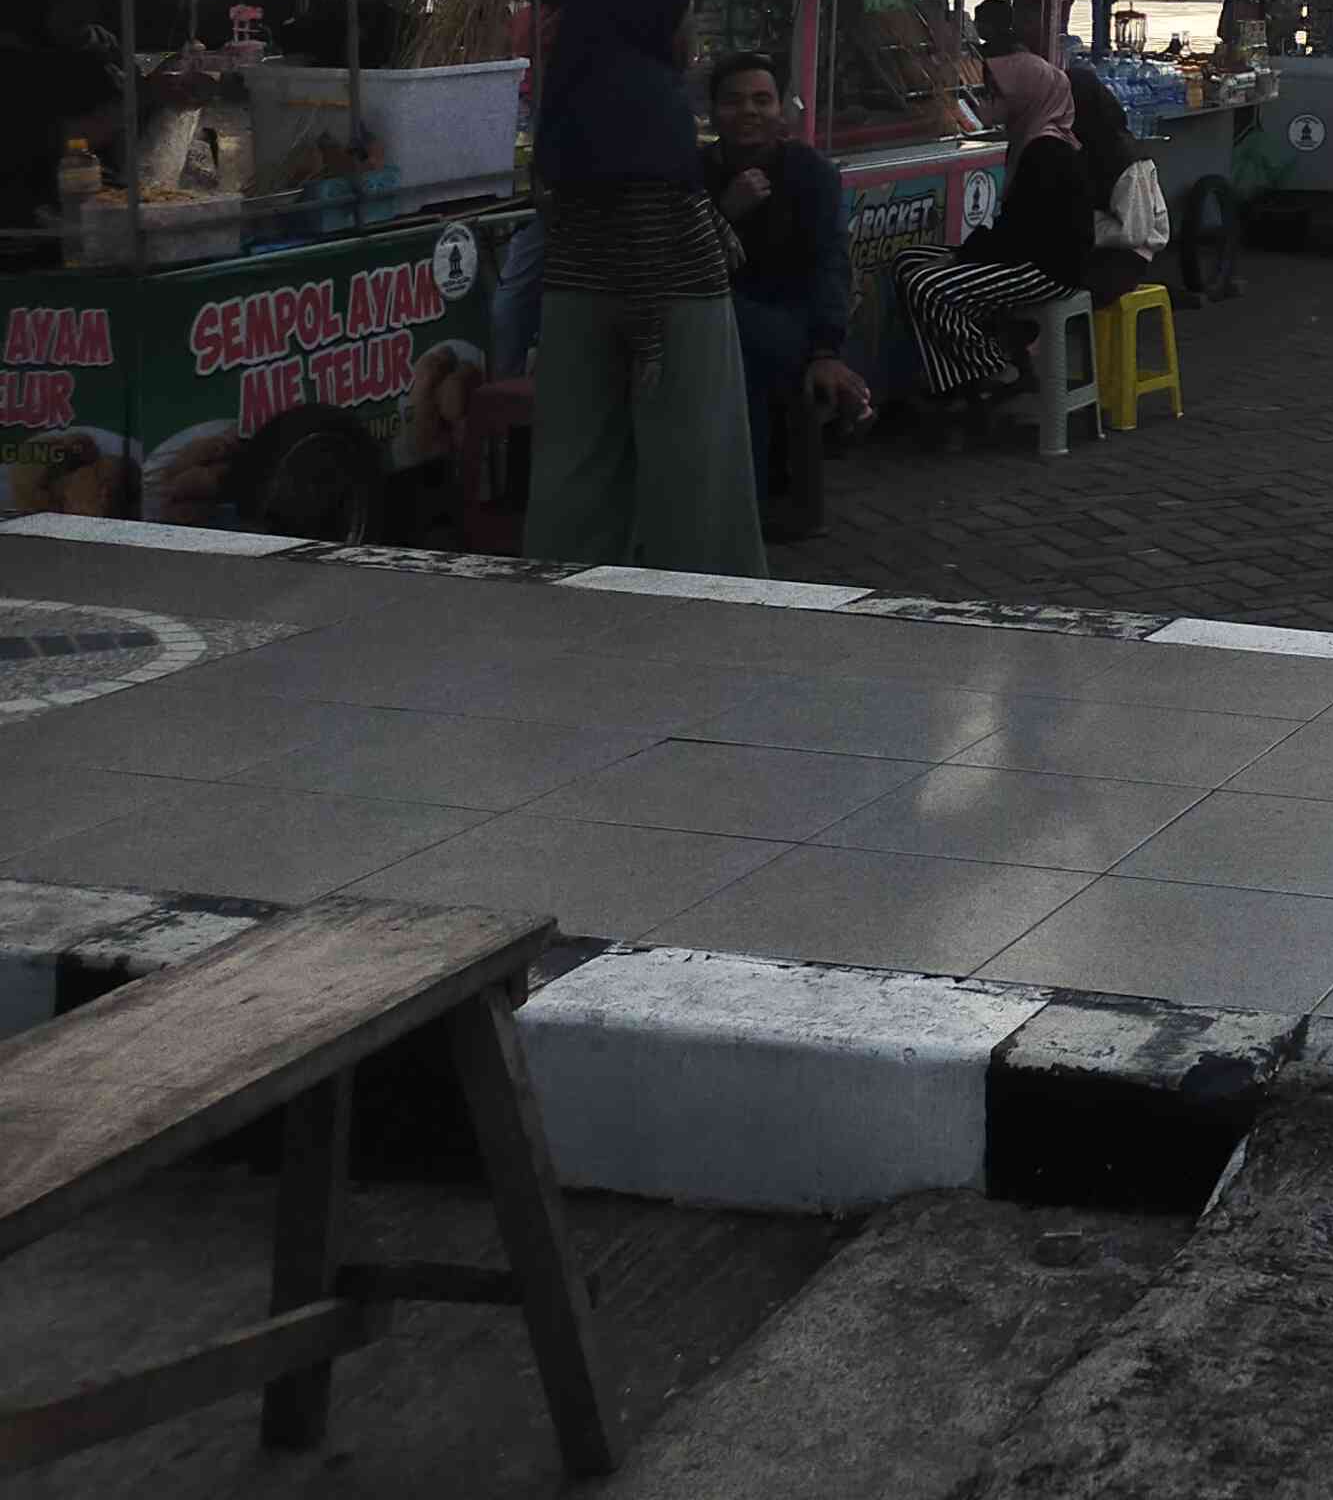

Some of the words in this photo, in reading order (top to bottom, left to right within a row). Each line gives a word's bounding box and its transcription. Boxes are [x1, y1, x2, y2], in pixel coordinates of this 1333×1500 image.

[861, 196, 935, 240] ROCKET
[3, 307, 115, 366] AYAM
[190, 278, 343, 376] SEMPOL
[346, 258, 446, 341] AYAM
[240, 354, 306, 438] MIE
[308, 328, 416, 409] TELUR
